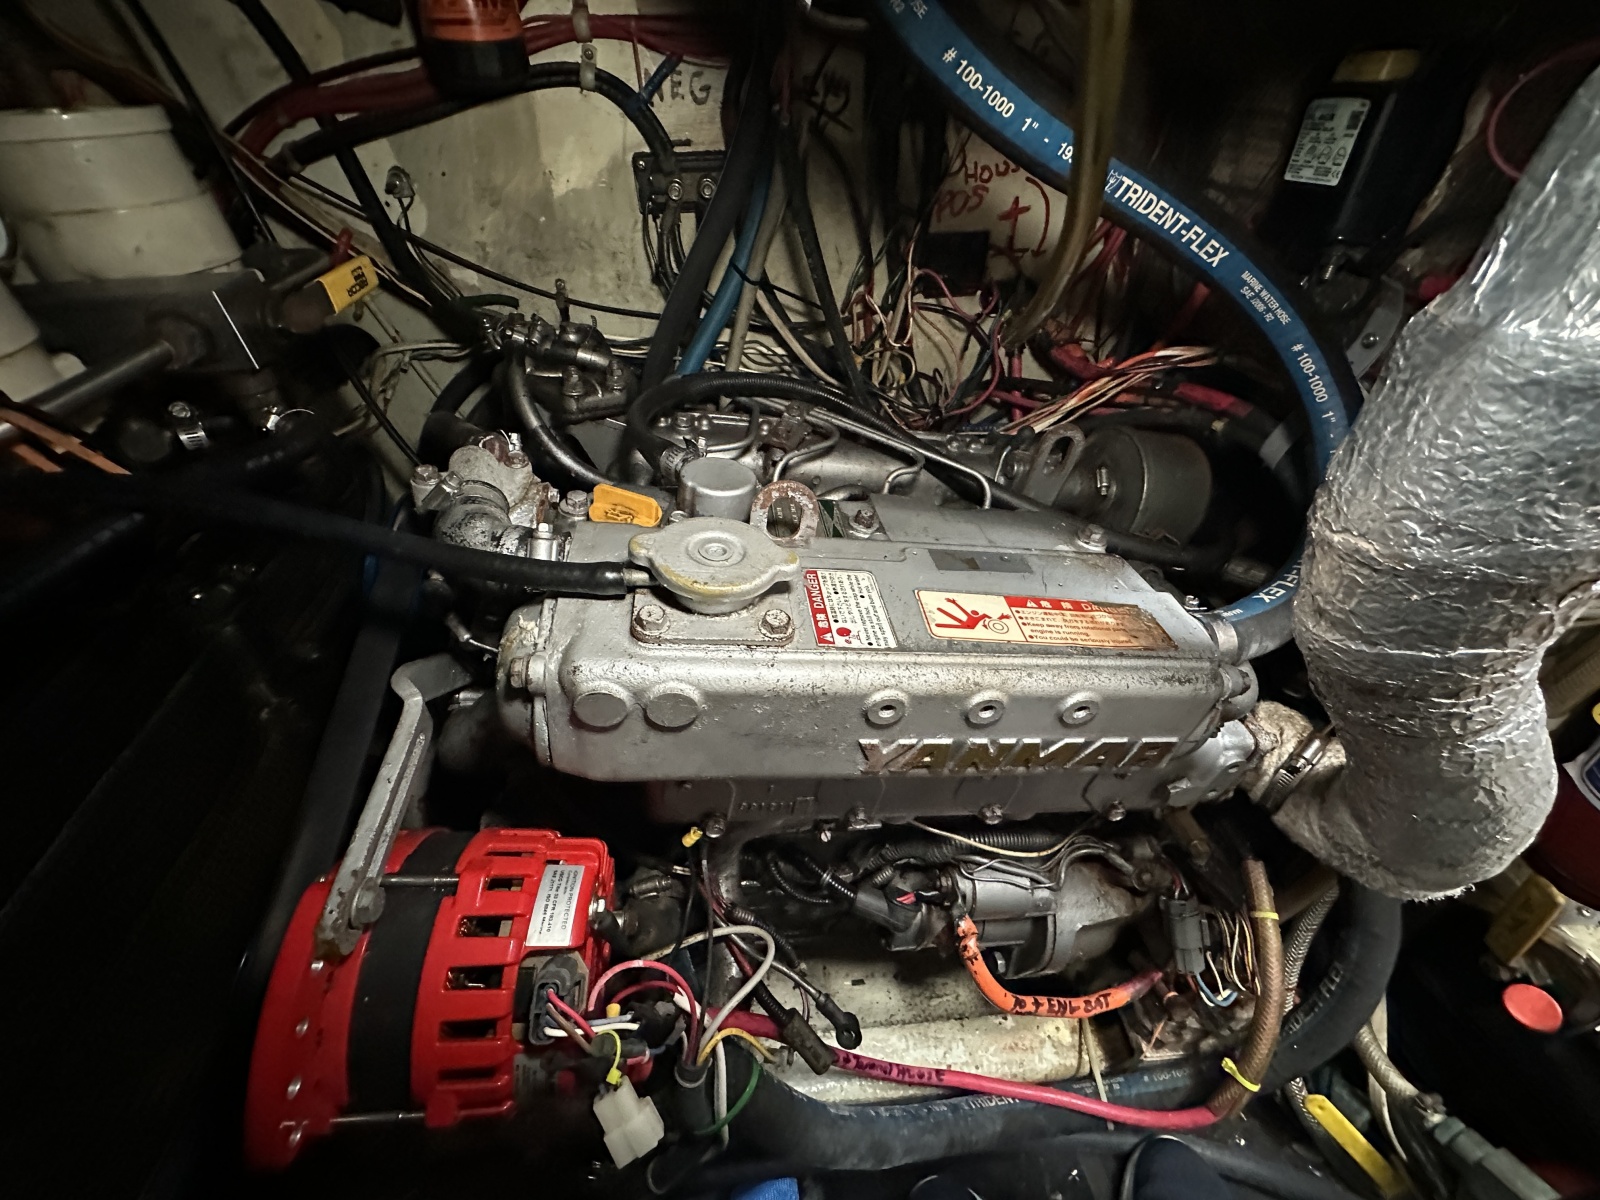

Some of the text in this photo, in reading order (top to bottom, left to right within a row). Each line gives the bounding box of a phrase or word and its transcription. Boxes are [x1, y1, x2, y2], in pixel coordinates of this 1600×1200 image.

[942, 46, 958, 63] #
[955, 59, 1016, 118] 100-1000
[934, 184, 989, 222] POS
[1114, 175, 1229, 268] TRIDENT-FLEX
[1240, 285, 1254, 300] SAE
[1241, 270, 1292, 325] MARINE WATER HOSE
[1291, 342, 1304, 354] #
[1297, 353, 1329, 404] 100-1000
[806, 573, 824, 608] DANGER
[862, 627, 871, 640] Never
[871, 630, 882, 646] engine
[858, 736, 1182, 776] YANMAR
[561, 893, 573, 930] PROTECTED
